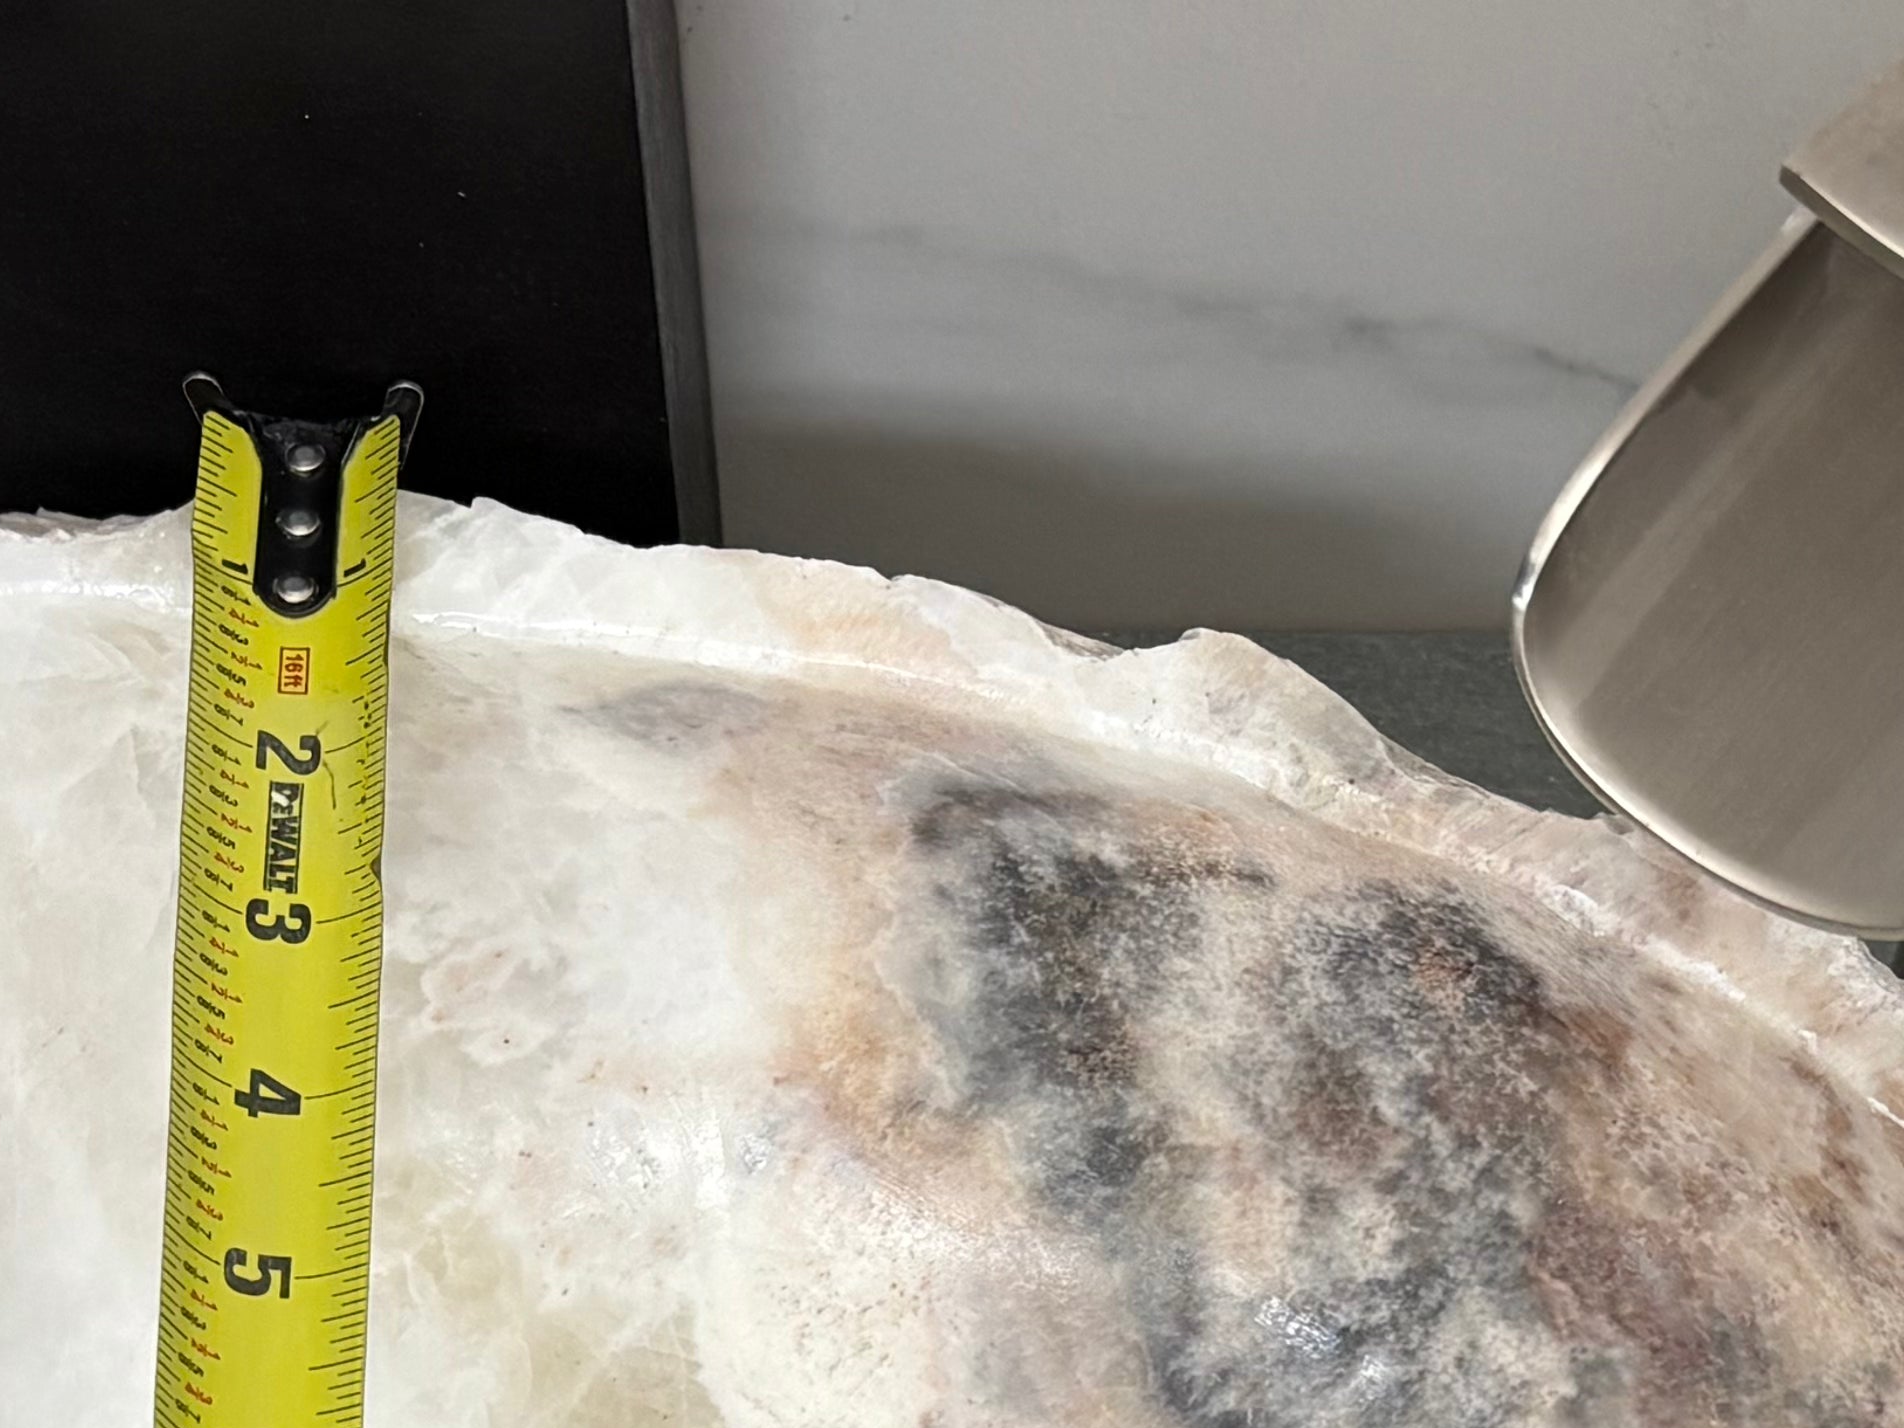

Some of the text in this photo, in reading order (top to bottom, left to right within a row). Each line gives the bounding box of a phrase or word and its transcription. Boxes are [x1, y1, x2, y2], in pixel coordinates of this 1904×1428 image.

[222, 559, 248, 572] 1
[345, 560, 366, 577] 1
[283, 652, 305, 689] 16ft
[255, 730, 321, 776] 2
[246, 898, 312, 944] 3
[234, 1068, 301, 1118] 4
[223, 1247, 292, 1299] 5
